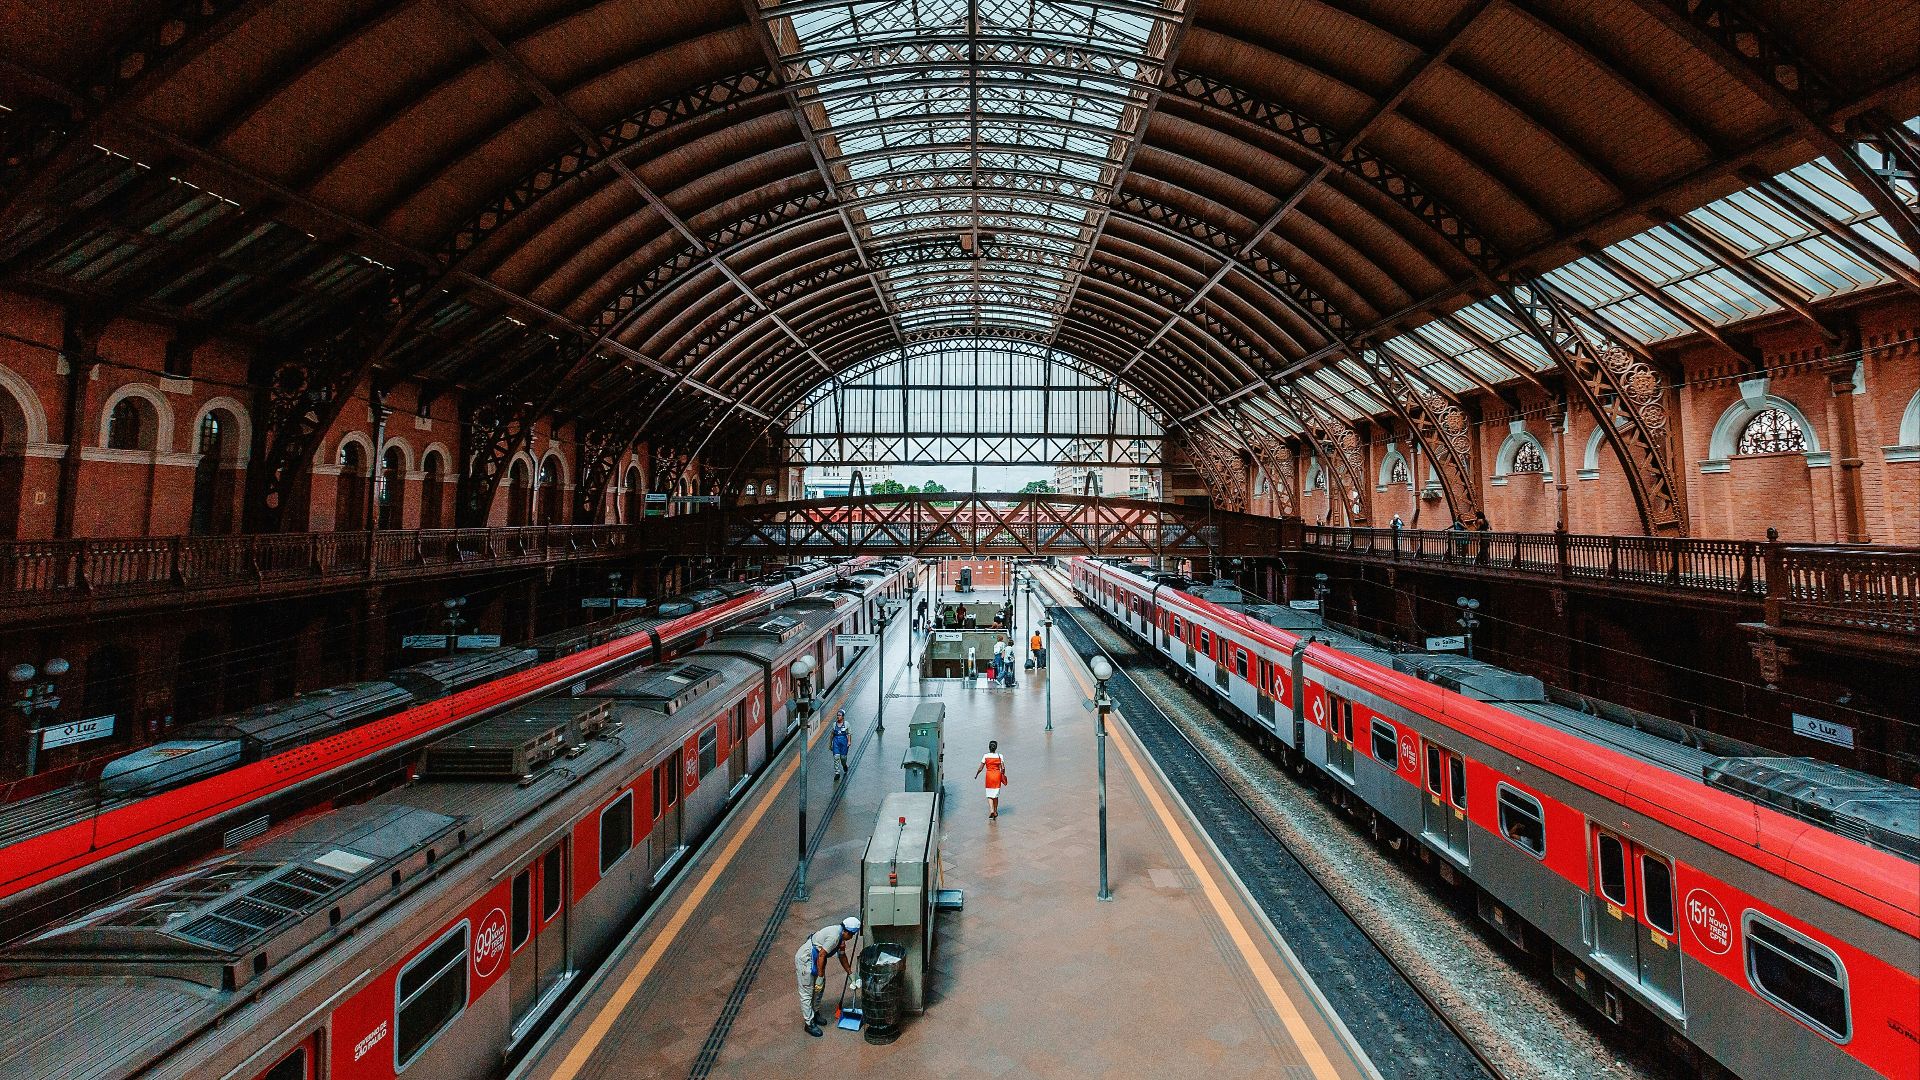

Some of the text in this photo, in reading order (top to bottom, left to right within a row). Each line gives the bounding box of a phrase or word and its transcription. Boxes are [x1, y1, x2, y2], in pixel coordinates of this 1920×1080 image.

[77, 722, 97, 733] Luz
[1820, 723, 1837, 736] Luz
[1689, 899, 1707, 928] 151
[1709, 916, 1728, 931] NOVO
[1709, 923, 1728, 939] TREM
[1709, 931, 1728, 946] CPTM
